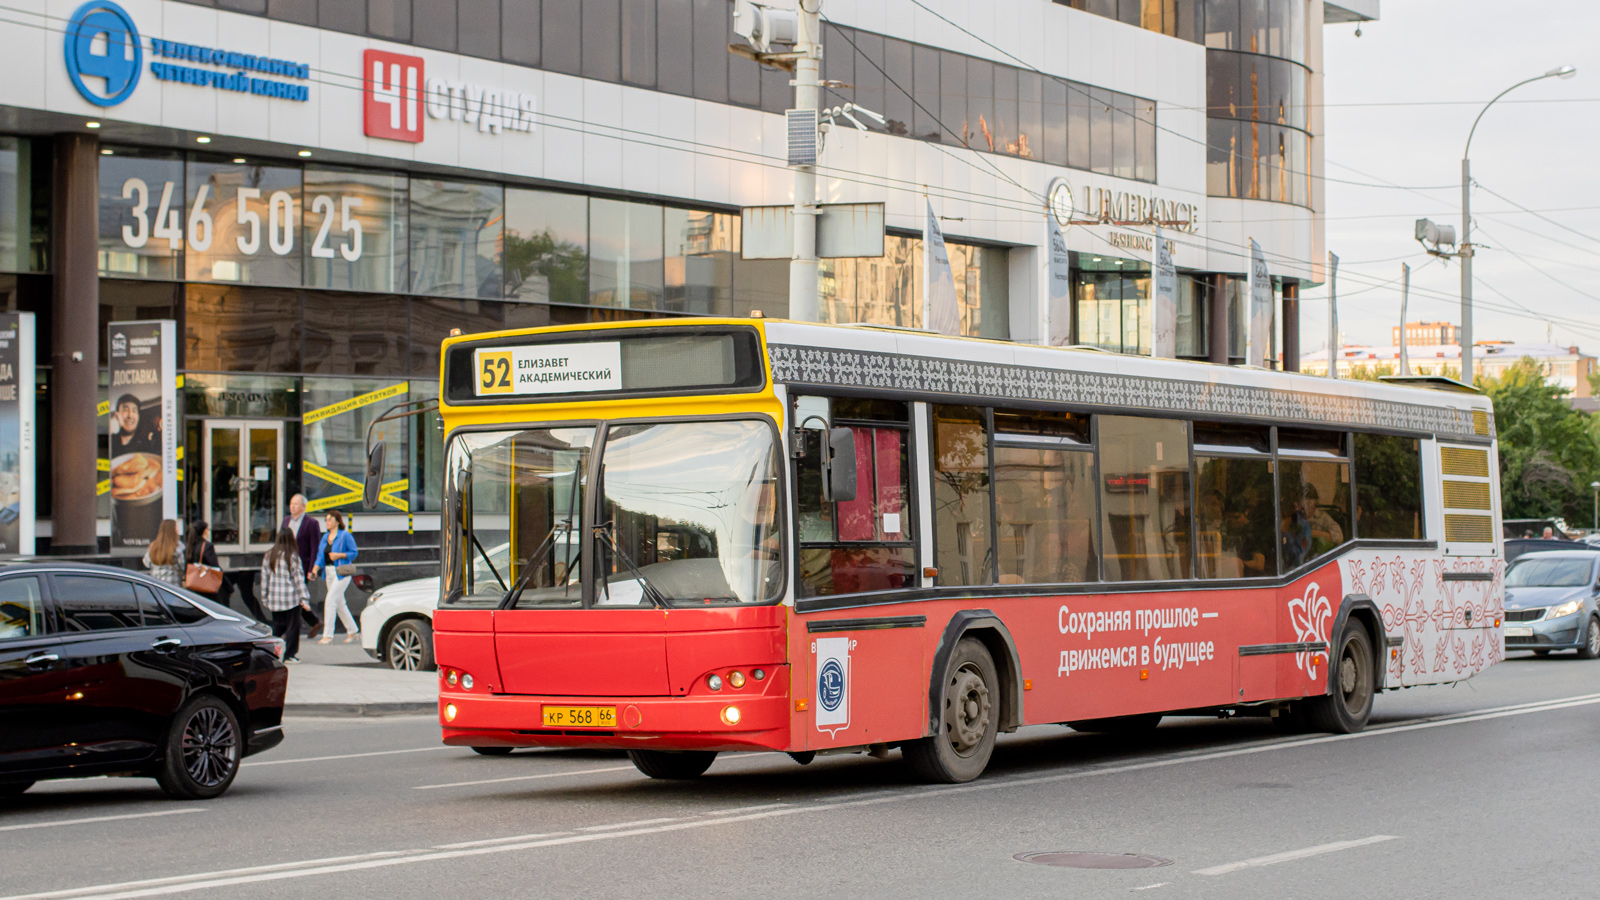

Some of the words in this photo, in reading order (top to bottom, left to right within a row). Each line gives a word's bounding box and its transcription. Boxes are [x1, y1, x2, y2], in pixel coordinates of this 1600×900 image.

[150, 37, 310, 80] ТЕЛЕКОМПАНИЯ
[150, 61, 251, 93] ЧЕТВЕРТЫЙ
[251, 77, 310, 102] КАНАЛ
[426, 77, 537, 135] СТУДИЯ
[121, 177, 213, 252] 346
[236, 186, 294, 256] 50
[311, 194, 363, 262] 25
[1084, 184, 1200, 233] LIMERANCE
[1109, 231, 1146, 250] FASHION
[112, 368, 158, 388] ДОСТАВКА
[482, 357, 511, 388] 52
[518, 357, 569, 369] ЕЛИЗАВЕТ
[519, 367, 612, 384] АКАДЕМИЧЕСКИЙ
[1058, 605, 1132, 641] Сохраняя
[1135, 606, 1199, 637] прошлое
[1057, 645, 1137, 678] движемся
[1141, 645, 1150, 666] в
[1153, 635, 1214, 672] будущее
[569, 709, 593, 724] 568
[599, 709, 612, 721] 66
